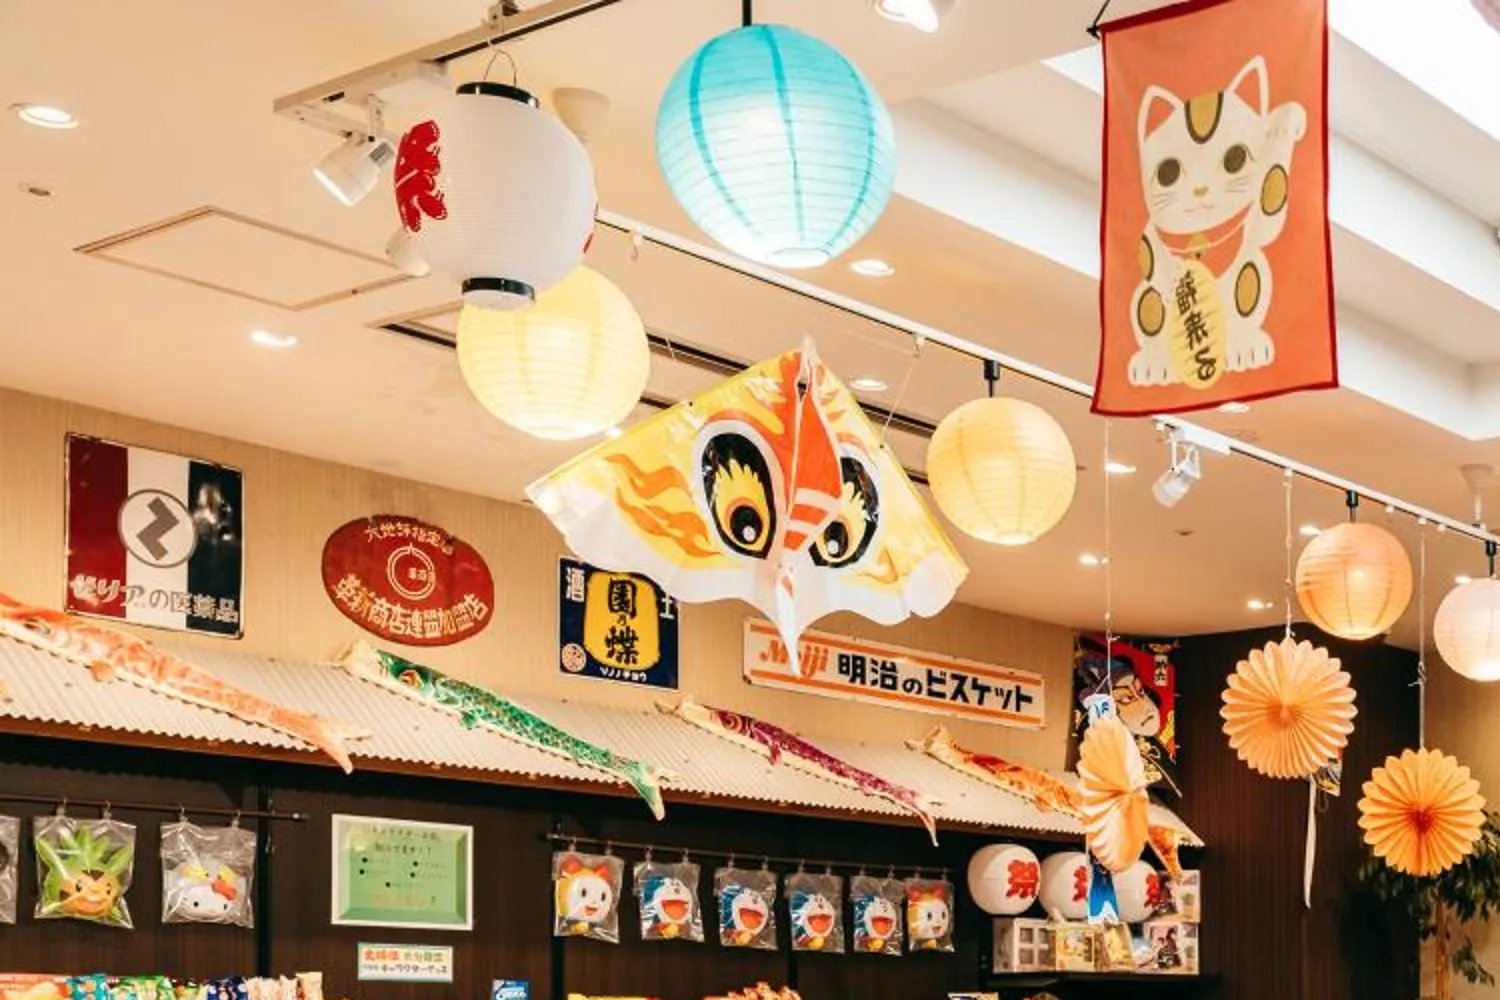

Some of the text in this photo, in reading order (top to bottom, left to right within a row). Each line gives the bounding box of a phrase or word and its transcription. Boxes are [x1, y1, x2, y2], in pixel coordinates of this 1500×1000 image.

[837, 652, 1034, 714] 明治のビスケット
